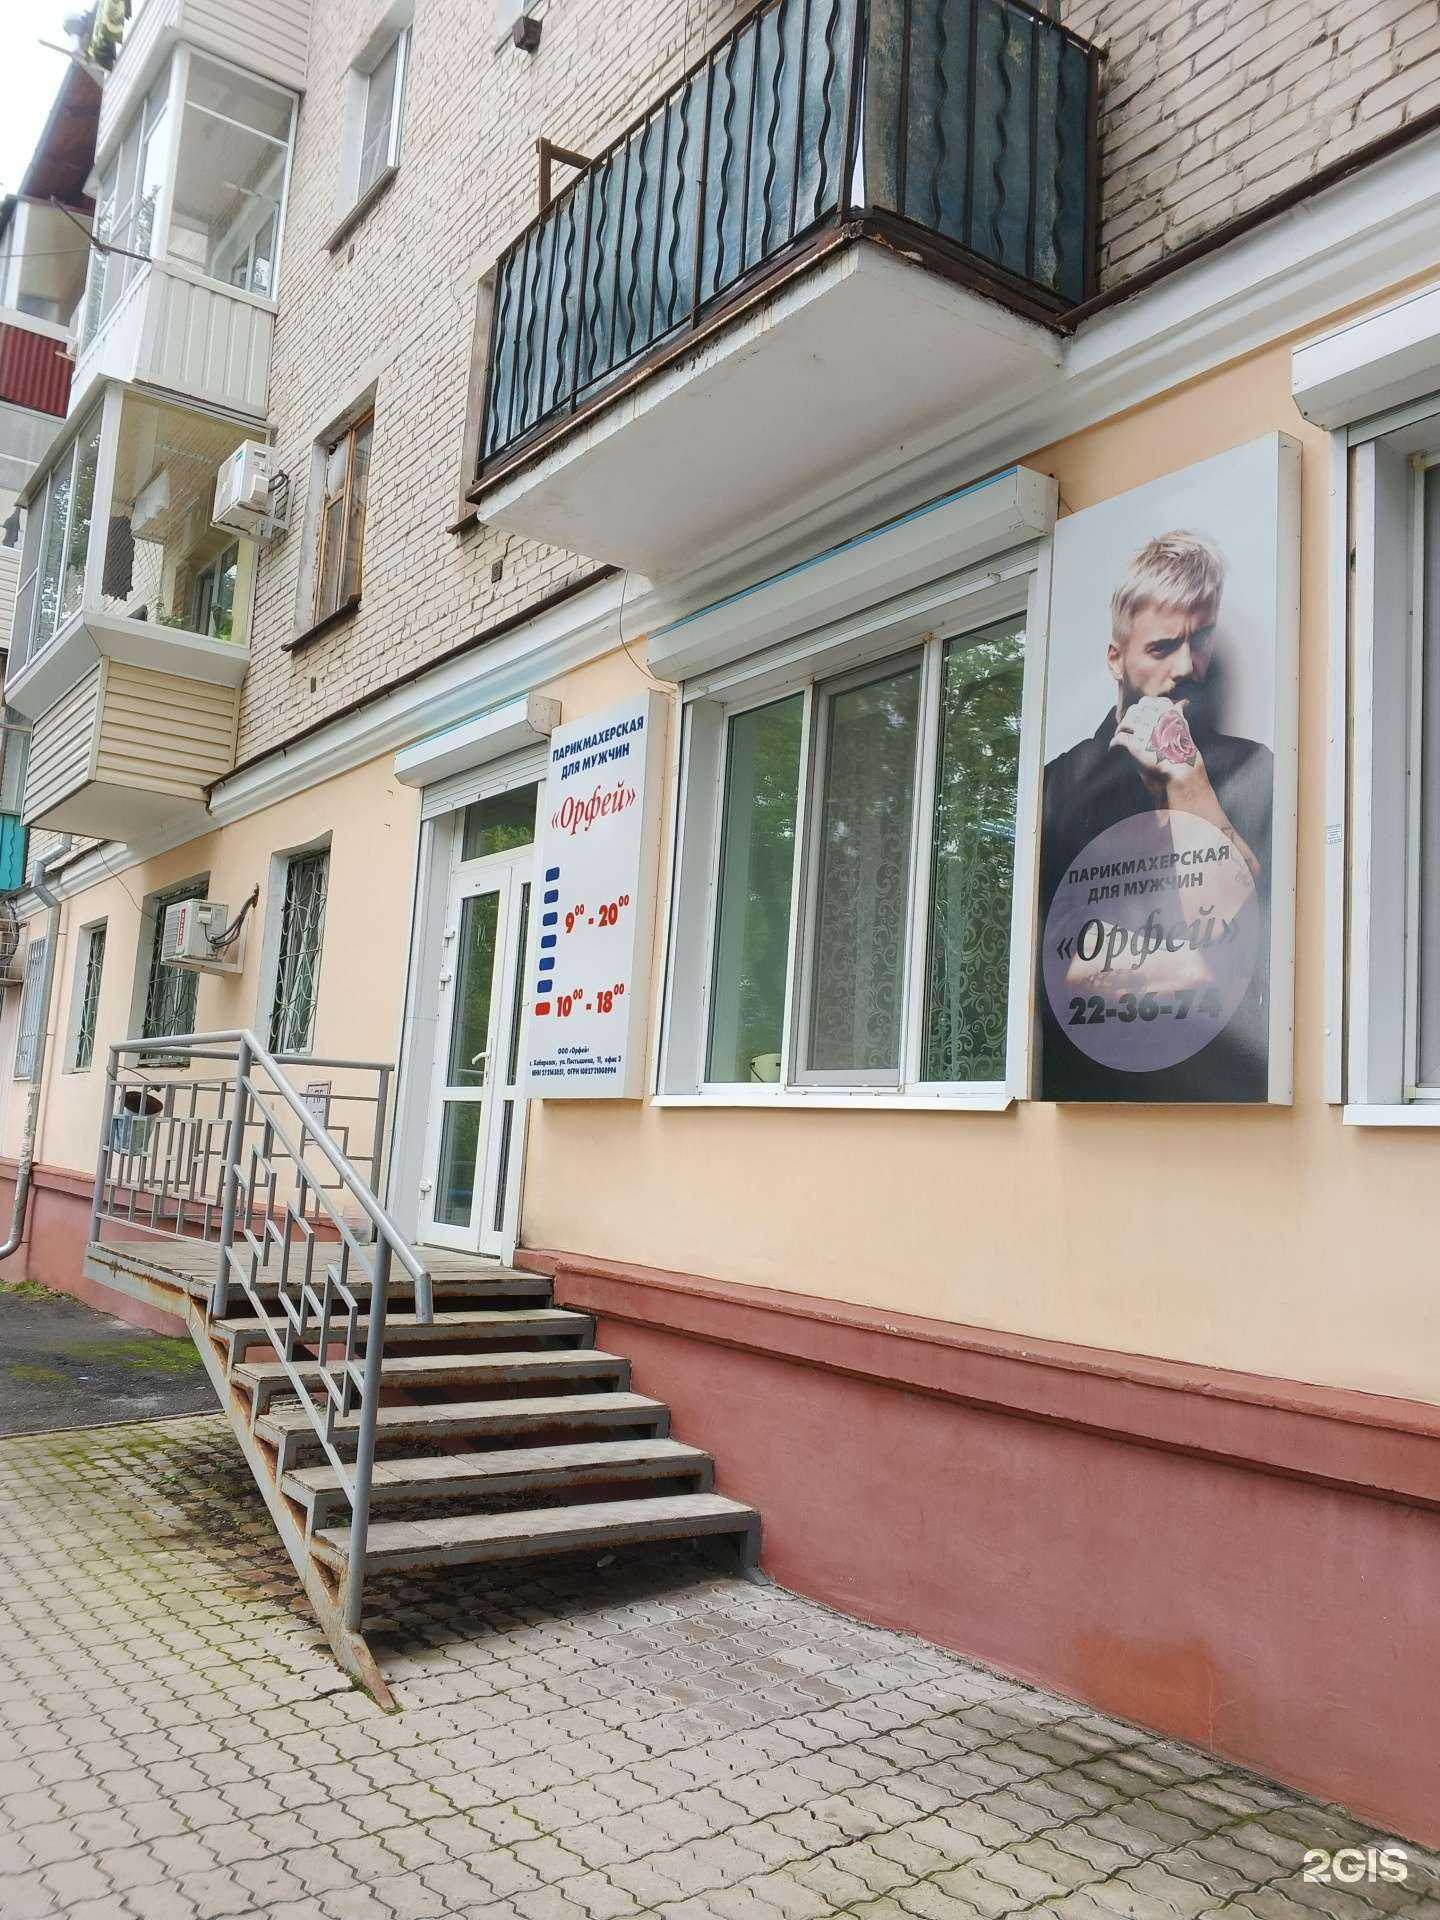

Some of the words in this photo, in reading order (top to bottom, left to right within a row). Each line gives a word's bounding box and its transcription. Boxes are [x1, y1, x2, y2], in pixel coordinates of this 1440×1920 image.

[552, 715, 644, 762] ПАРИКМАХЕРСКАЯ
[561, 761, 580, 780] ДЛЯ
[582, 742, 630, 771] МУЖЧИН
[551, 777, 636, 836] «Орфей»
[1068, 845, 1231, 884] ПАРИКМАХЕРСКАЯ
[1088, 884, 1120, 905] ДЛЯ
[1124, 871, 1204, 893] МУЖЧИН
[1056, 904, 1240, 973] «Орфей»
